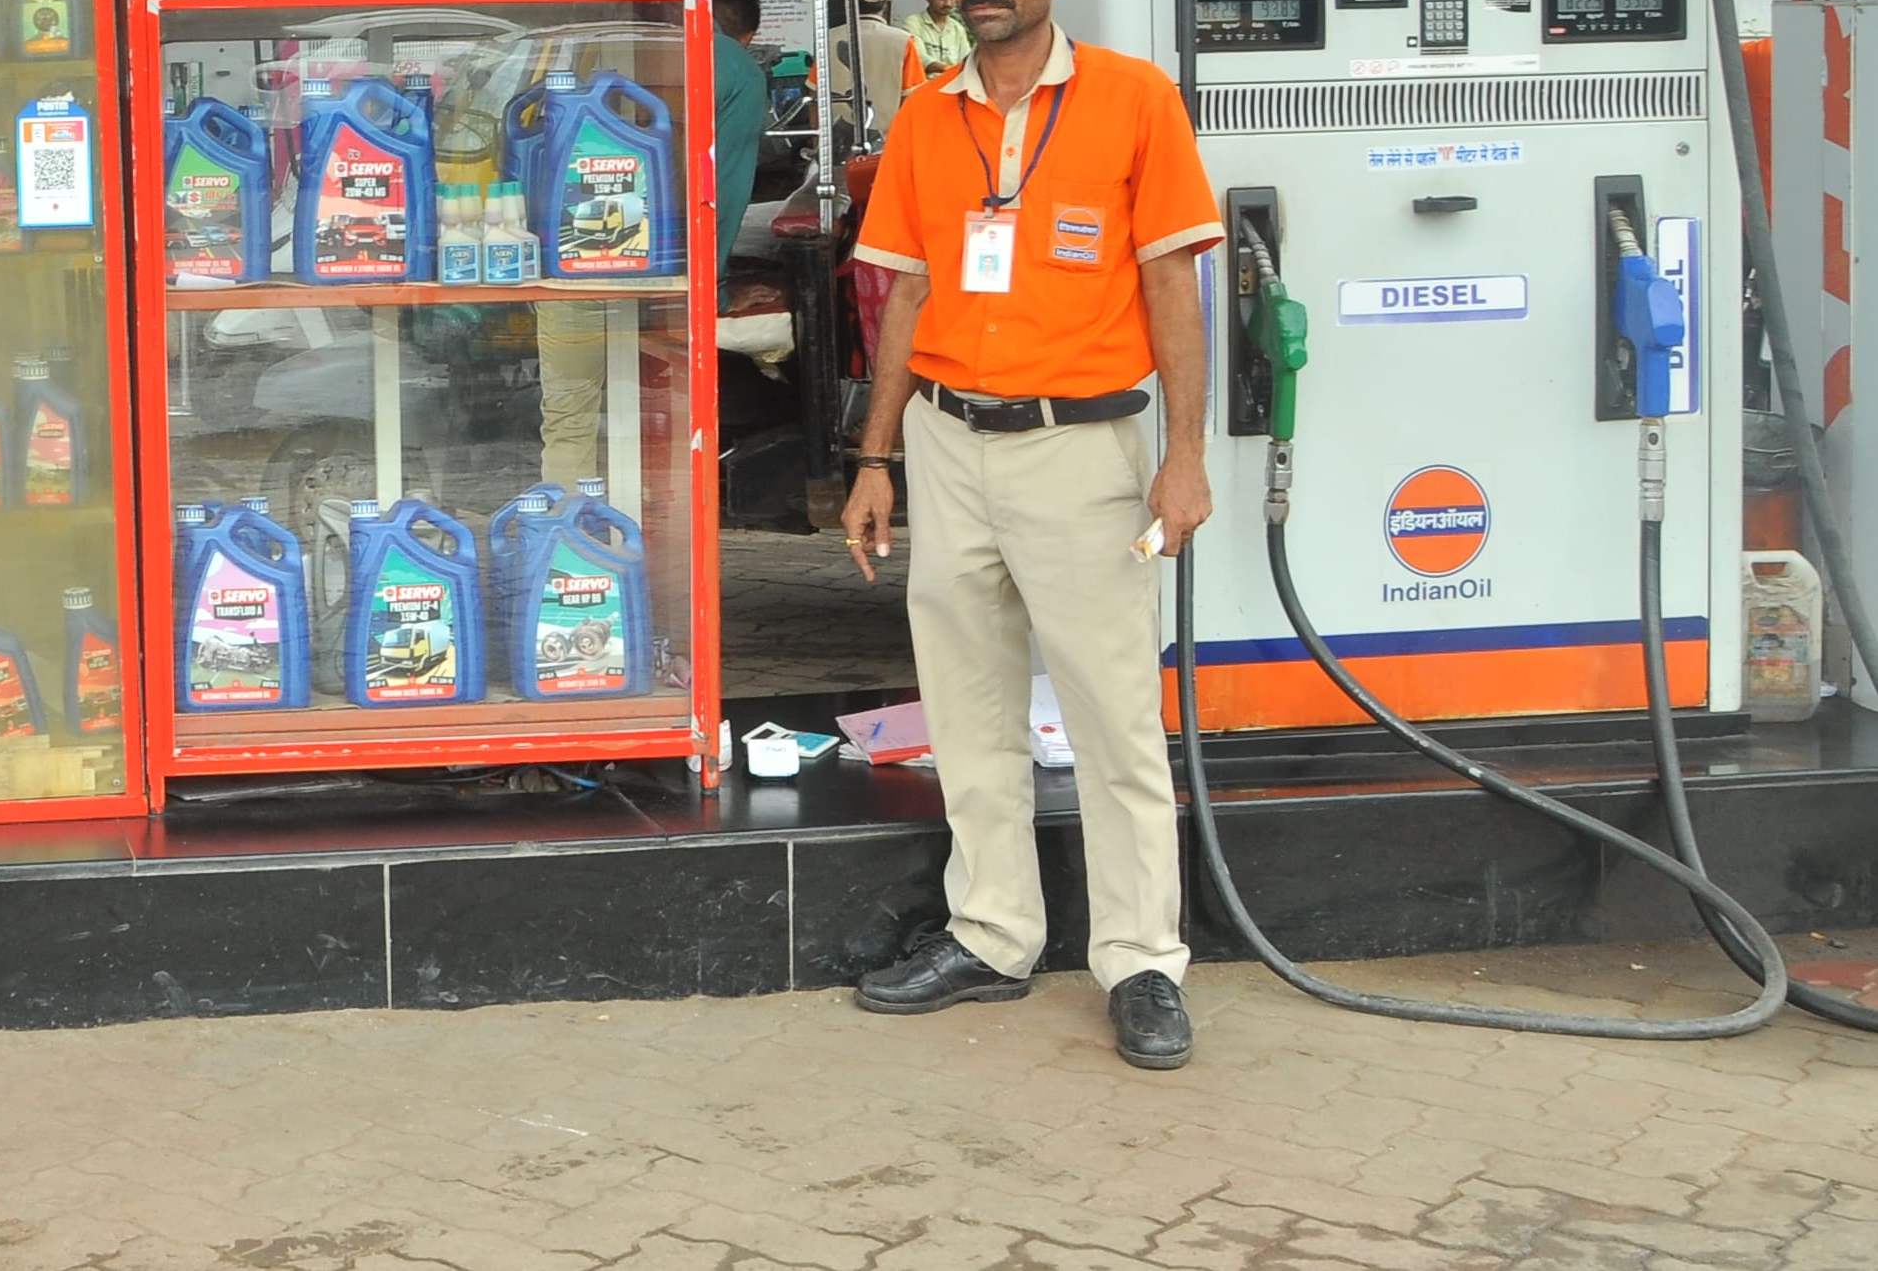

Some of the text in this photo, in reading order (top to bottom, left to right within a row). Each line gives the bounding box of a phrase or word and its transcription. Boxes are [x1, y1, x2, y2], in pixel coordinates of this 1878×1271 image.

[350, 162, 393, 175] SERVO
[592, 159, 635, 171] SERVO
[194, 177, 229, 187] SERVO
[354, 177, 377, 187] SUPER
[582, 173, 614, 184] PREMIUM
[1380, 283, 1487, 309] DIESEL
[1669, 259, 1685, 370] DEL
[1389, 506, 1484, 536] इंडियनऑयल
[566, 578, 610, 592] SERVO
[1382, 577, 1492, 603] IndianOil
[223, 589, 267, 602] SERVO
[399, 586, 441, 600] SERVO
[562, 594, 581, 605] GEAR
[389, 602, 421, 613] PREMIUM
